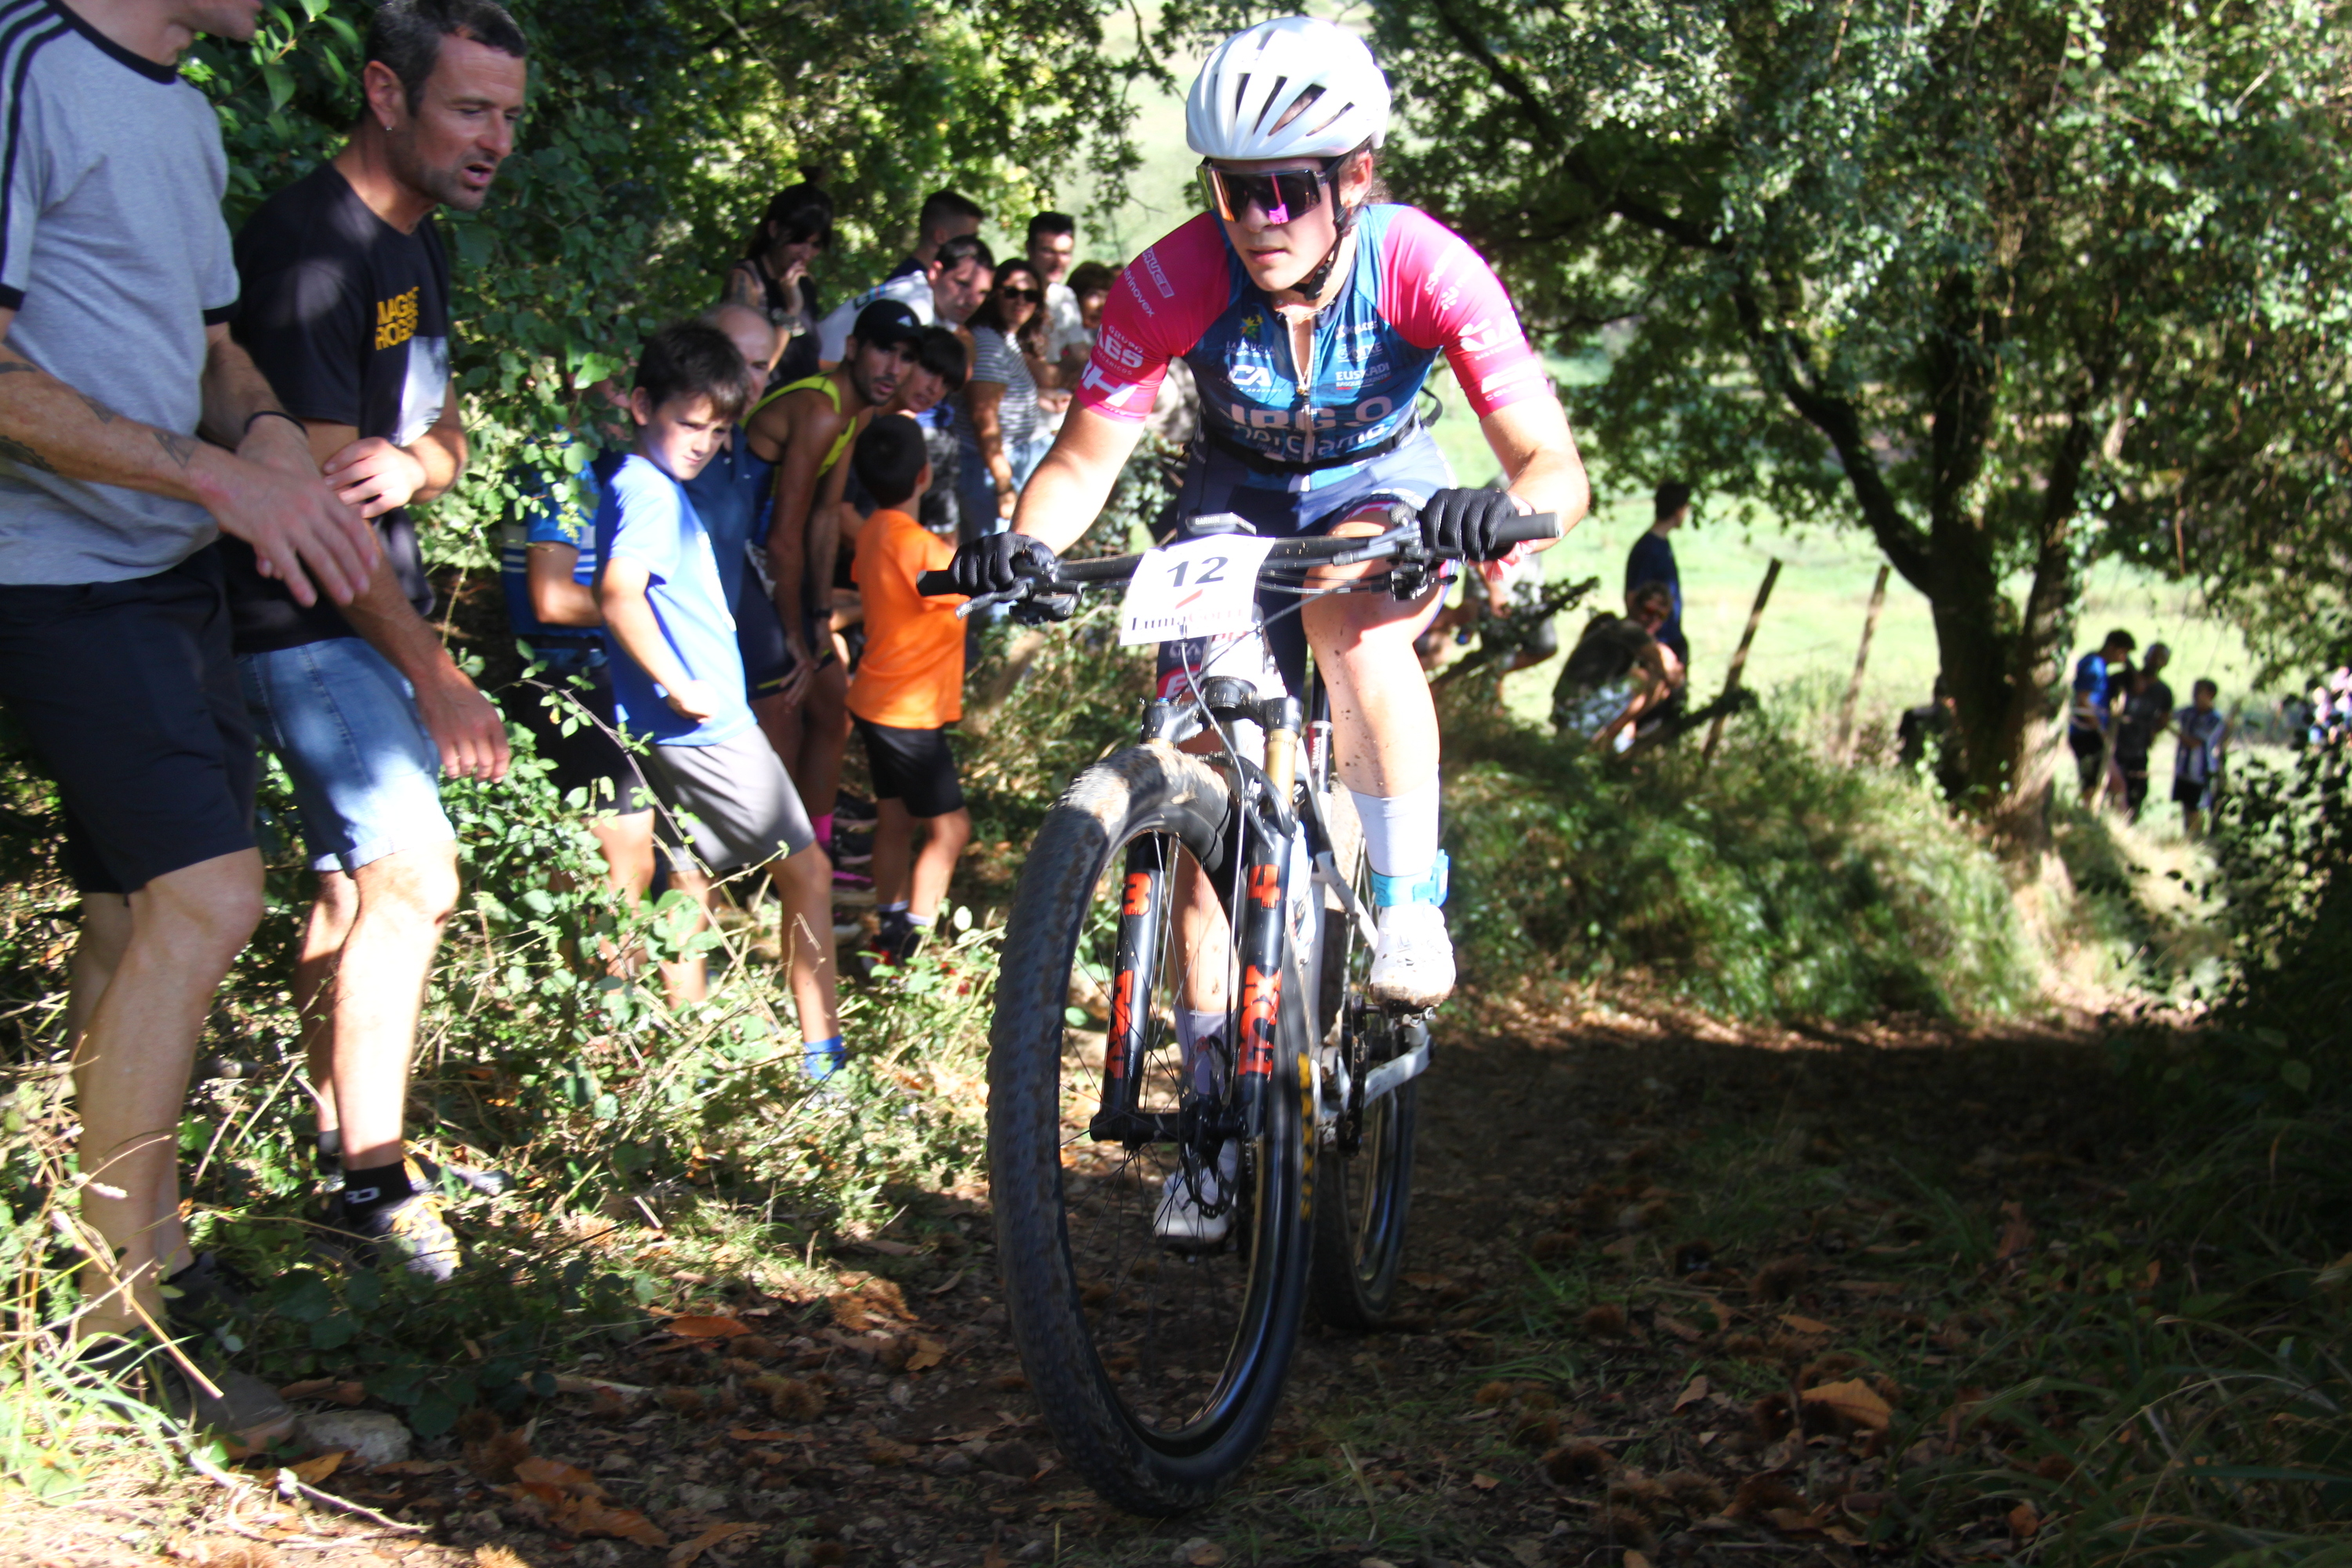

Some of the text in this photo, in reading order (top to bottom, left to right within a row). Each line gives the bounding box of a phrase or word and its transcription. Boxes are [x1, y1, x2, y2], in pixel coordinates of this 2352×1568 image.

[1123, 265, 1155, 318] utrinovex
[1335, 362, 1391, 382] EUSKADI
[1195, 516, 1221, 526] GARMIN
[1167, 556, 1229, 587] 12
[1238, 964, 1283, 1078] FOX
